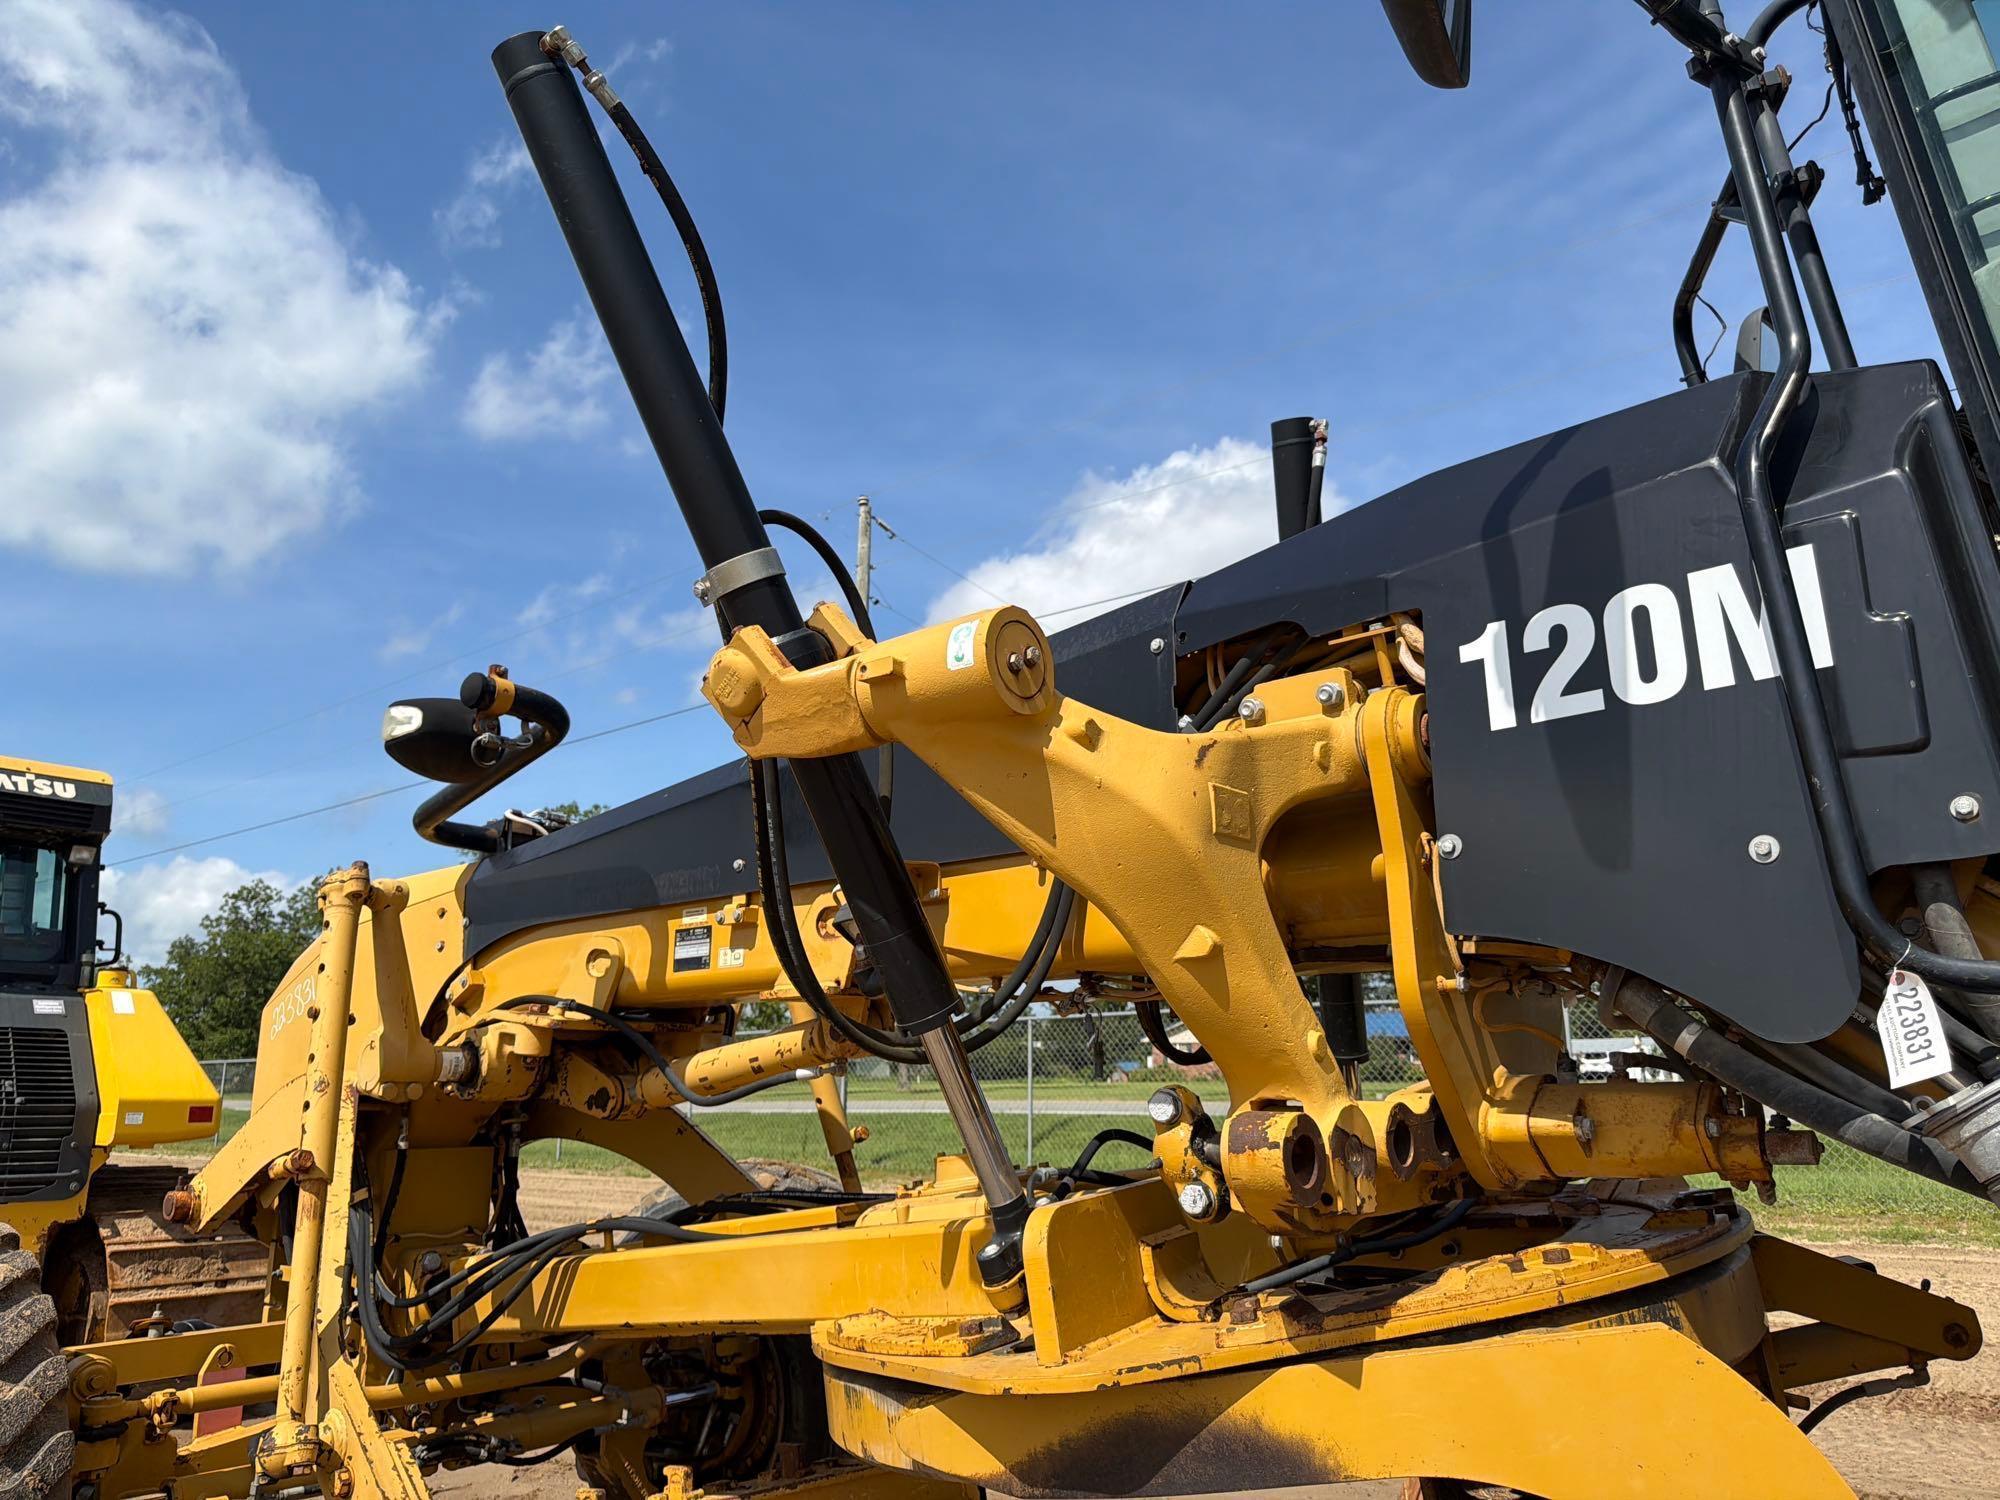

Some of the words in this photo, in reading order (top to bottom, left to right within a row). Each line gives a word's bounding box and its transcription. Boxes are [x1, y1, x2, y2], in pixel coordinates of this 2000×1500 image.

[1458, 544, 1834, 732] 120M
[270, 975, 316, 1041] 223831
[1889, 1016, 1900, 1041] AUCTION
[1895, 1041, 1906, 1069] COMPANY
[1892, 987, 1936, 1066] 223831
